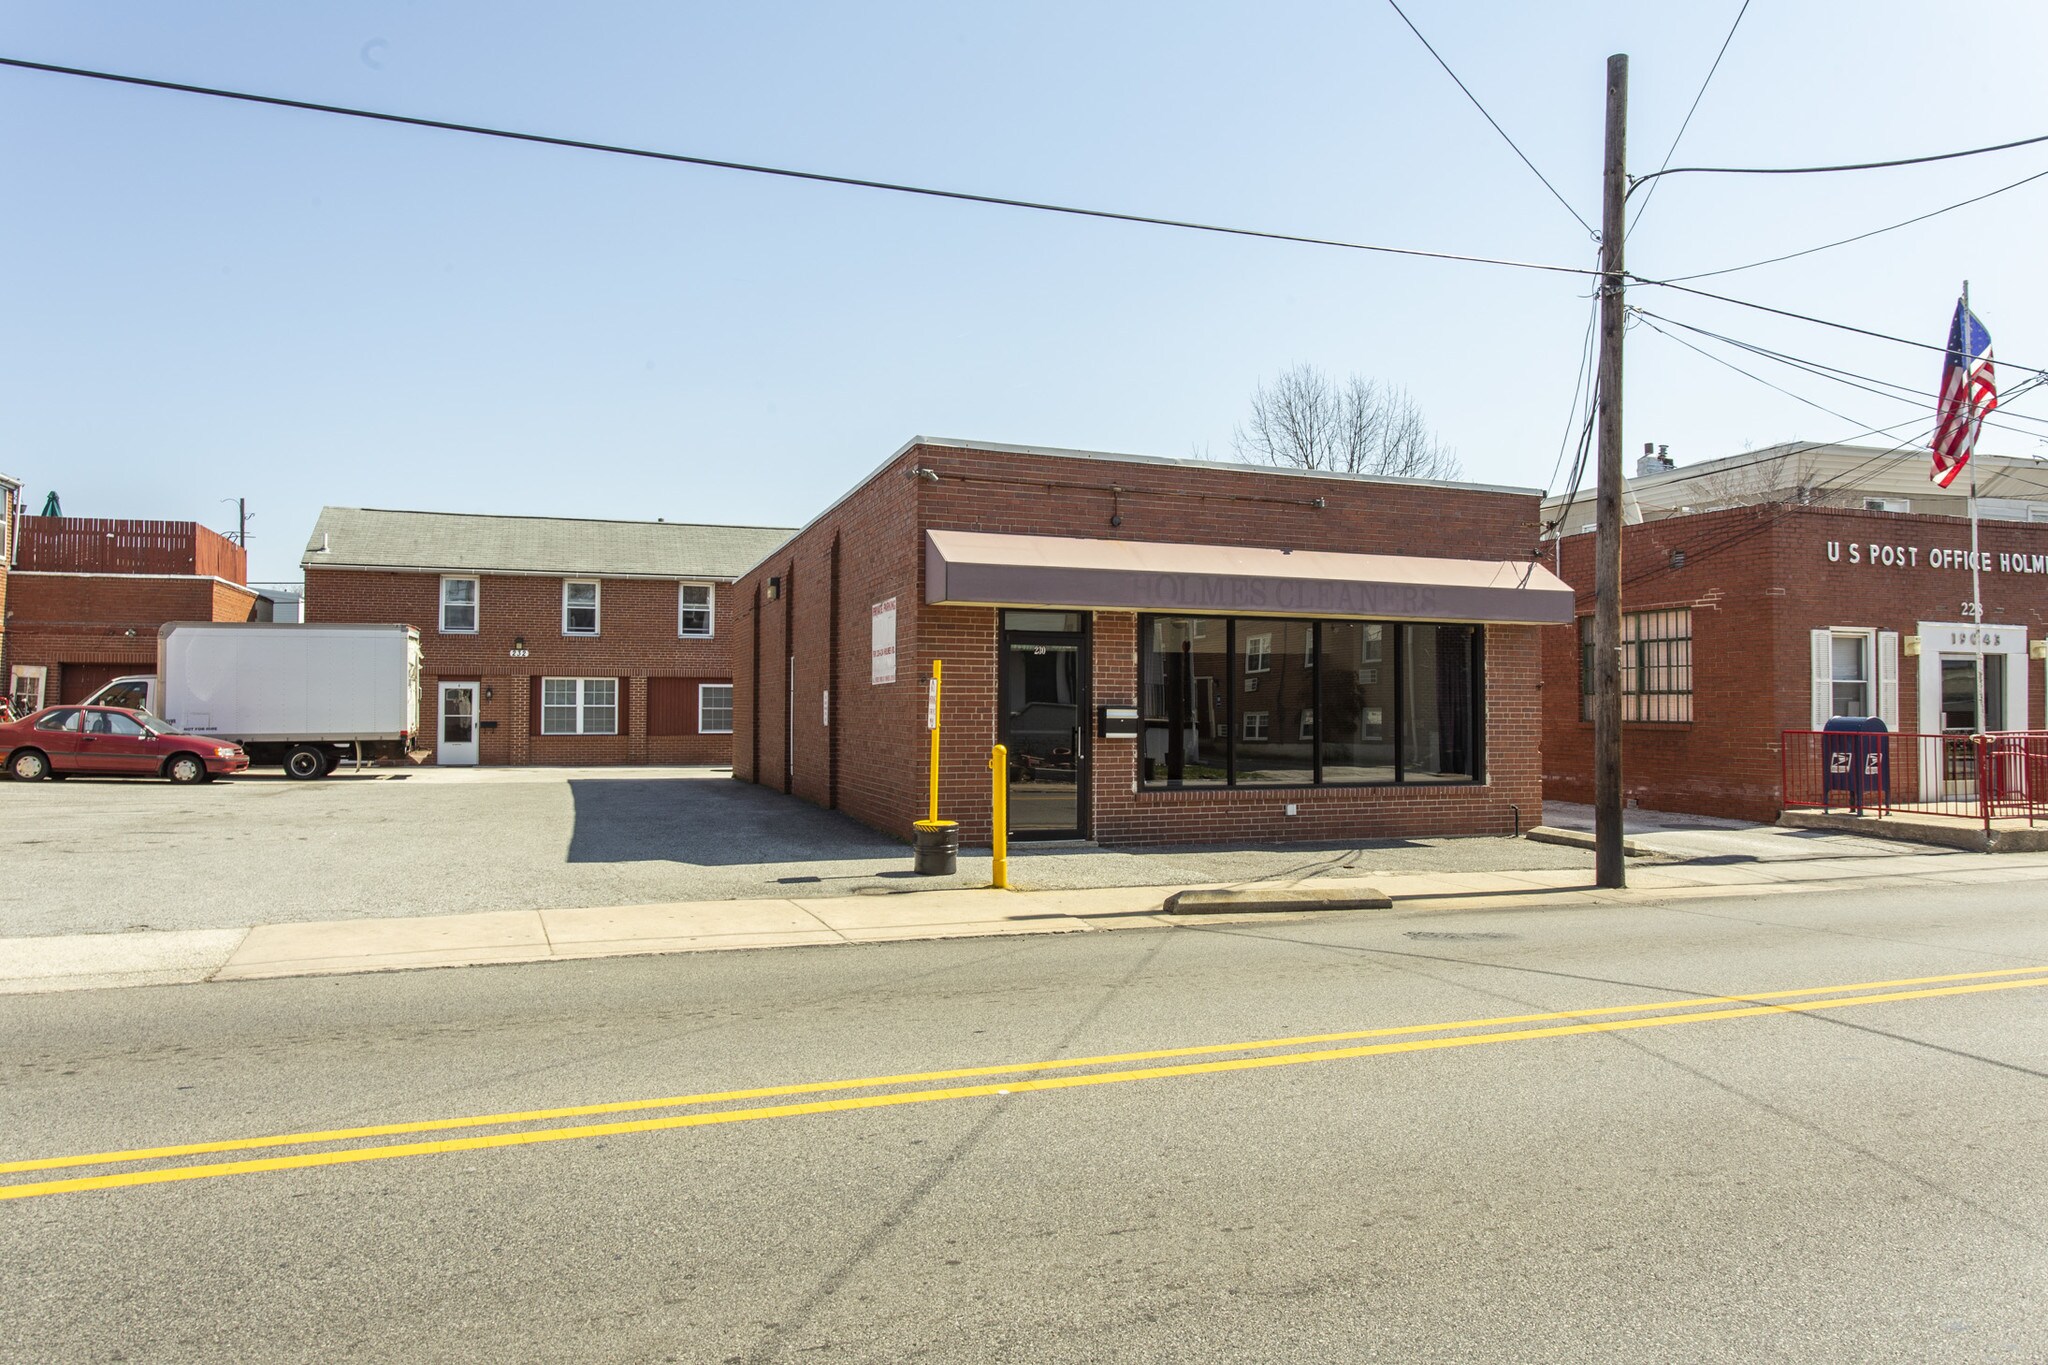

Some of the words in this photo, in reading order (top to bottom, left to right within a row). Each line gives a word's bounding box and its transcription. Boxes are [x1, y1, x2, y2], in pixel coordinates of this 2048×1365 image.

[1827, 541, 1840, 562] U
[1849, 543, 1860, 564] S
[1869, 544, 1918, 567] POST
[1929, 548, 1992, 572] OFFICE
[1133, 573, 1268, 608] HOLMES
[1275, 579, 1437, 614] CLEANERS
